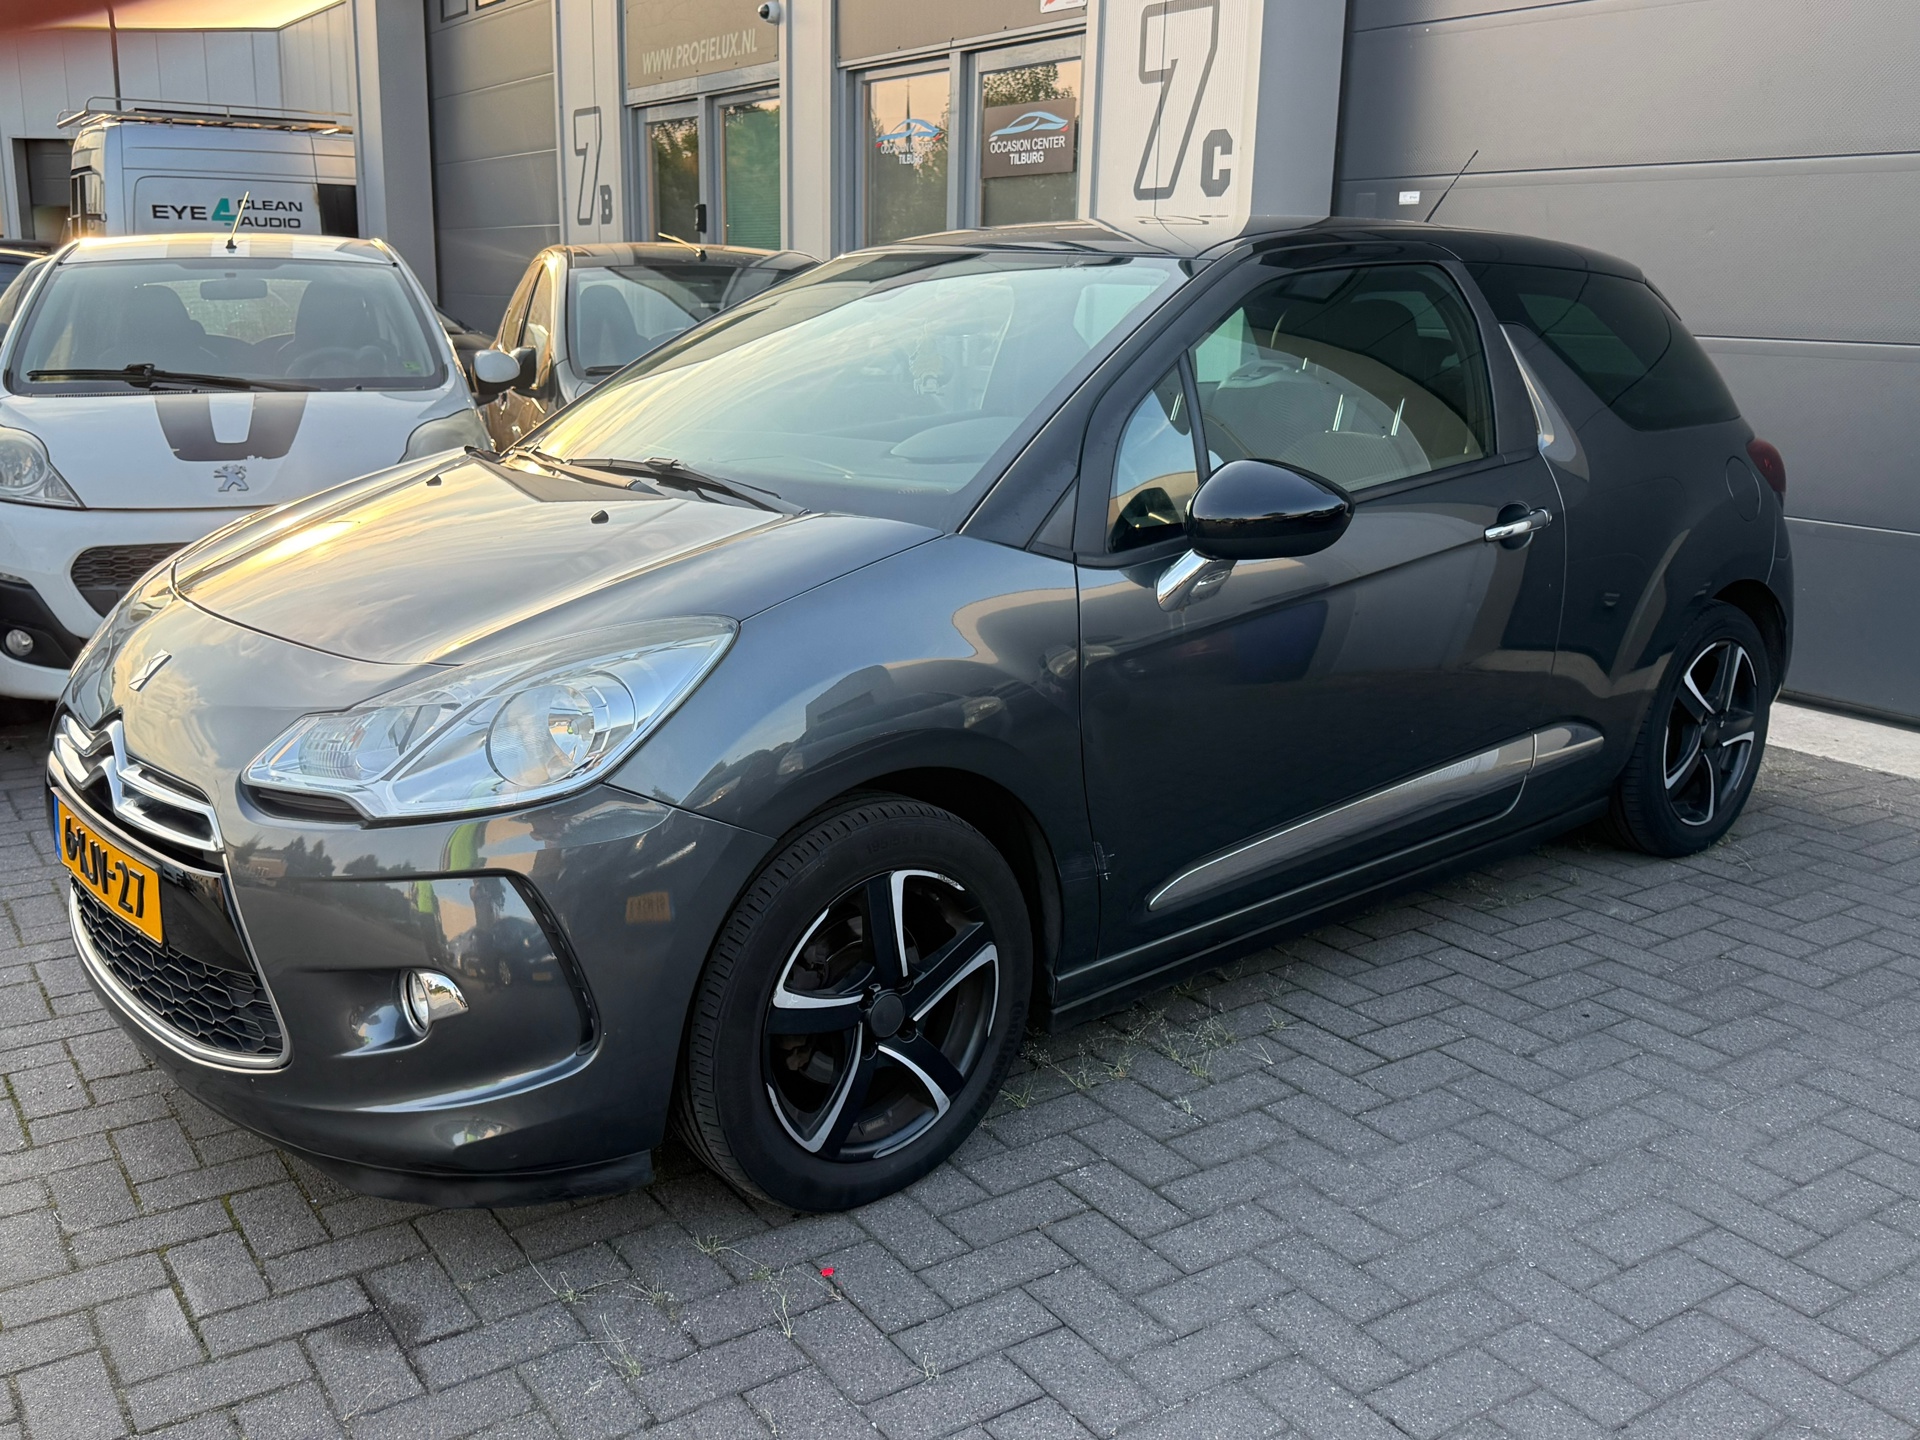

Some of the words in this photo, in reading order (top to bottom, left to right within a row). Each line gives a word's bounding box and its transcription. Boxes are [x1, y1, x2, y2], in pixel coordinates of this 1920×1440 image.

[642, 28, 757, 75] WWW.PROFIELUX.NL
[1133, 0, 1221, 201] 7
[1200, 128, 1233, 198] C
[990, 138, 1031, 154] OCCASION
[1031, 135, 1066, 150] CENTER
[573, 105, 602, 226] 7
[600, 184, 613, 225] B
[1009, 151, 1045, 165] TILBURG
[151, 204, 207, 221] EYE
[211, 197, 237, 226] 4
[237, 199, 303, 212] CLEAN
[240, 216, 301, 228] AUDIO
